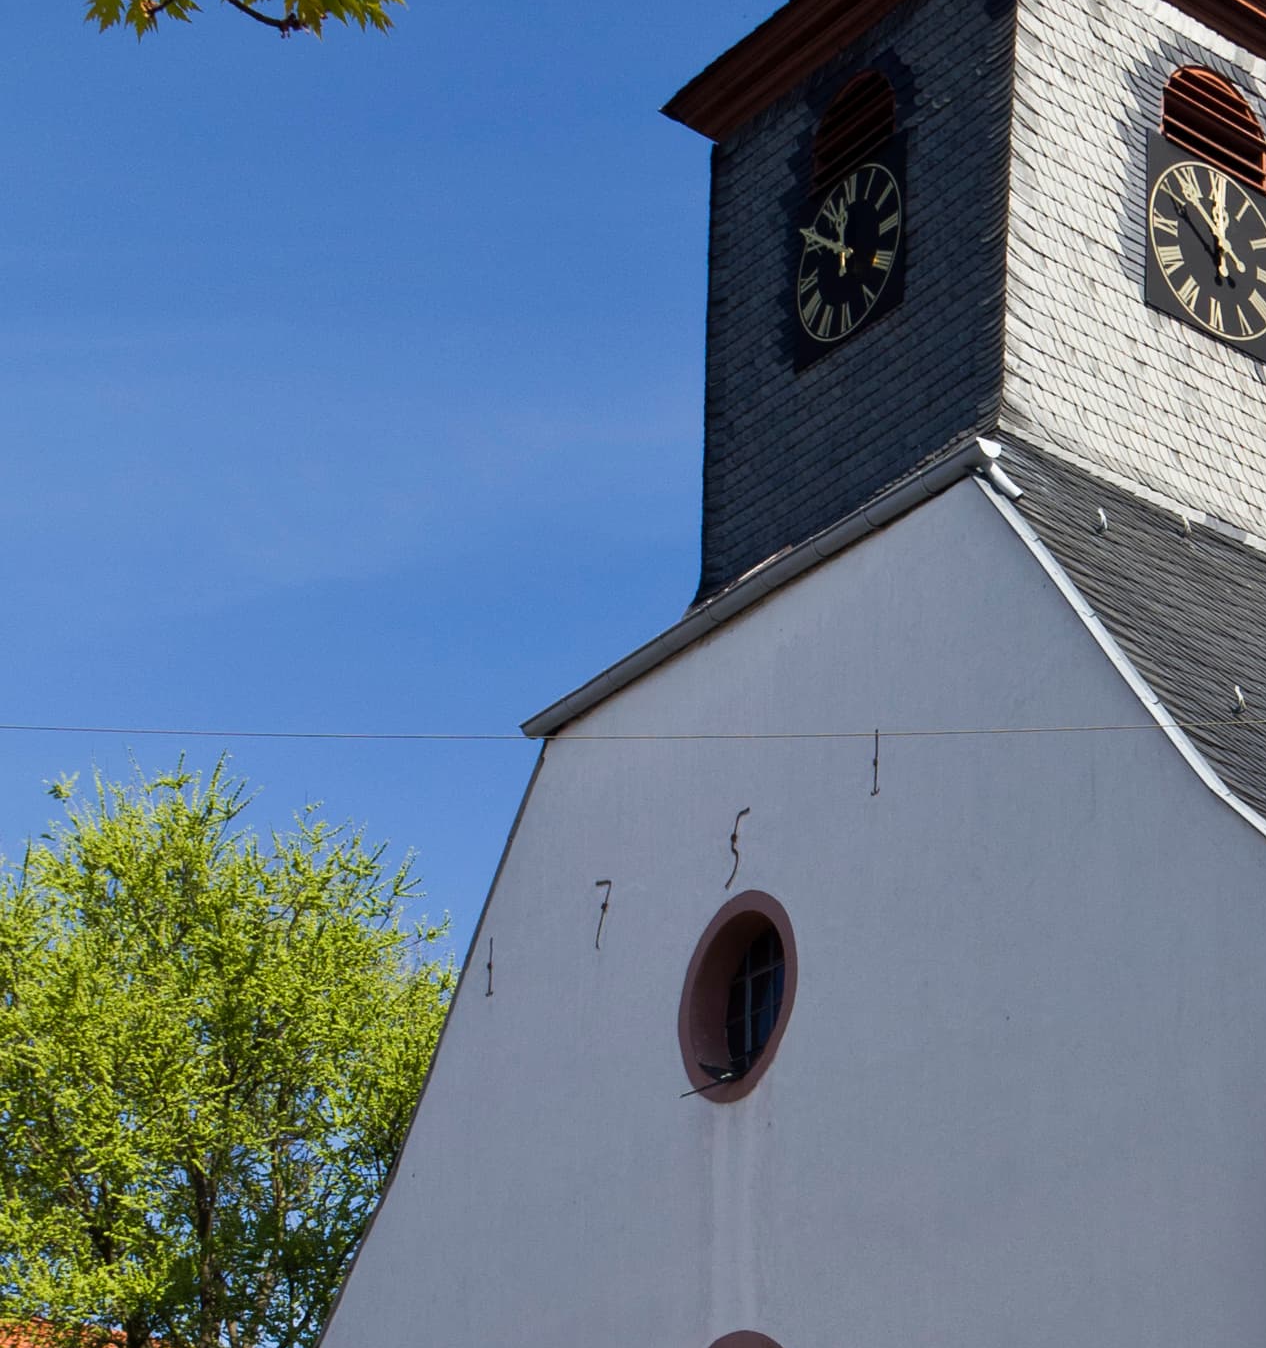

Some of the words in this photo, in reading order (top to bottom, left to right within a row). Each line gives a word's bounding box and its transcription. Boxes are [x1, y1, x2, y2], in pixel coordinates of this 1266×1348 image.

[865, 168, 876, 200] I
[1160, 178, 1186, 206] X
[879, 212, 898, 235] III
[1234, 199, 1250, 222] I
[1236, 304, 1254, 336] V
